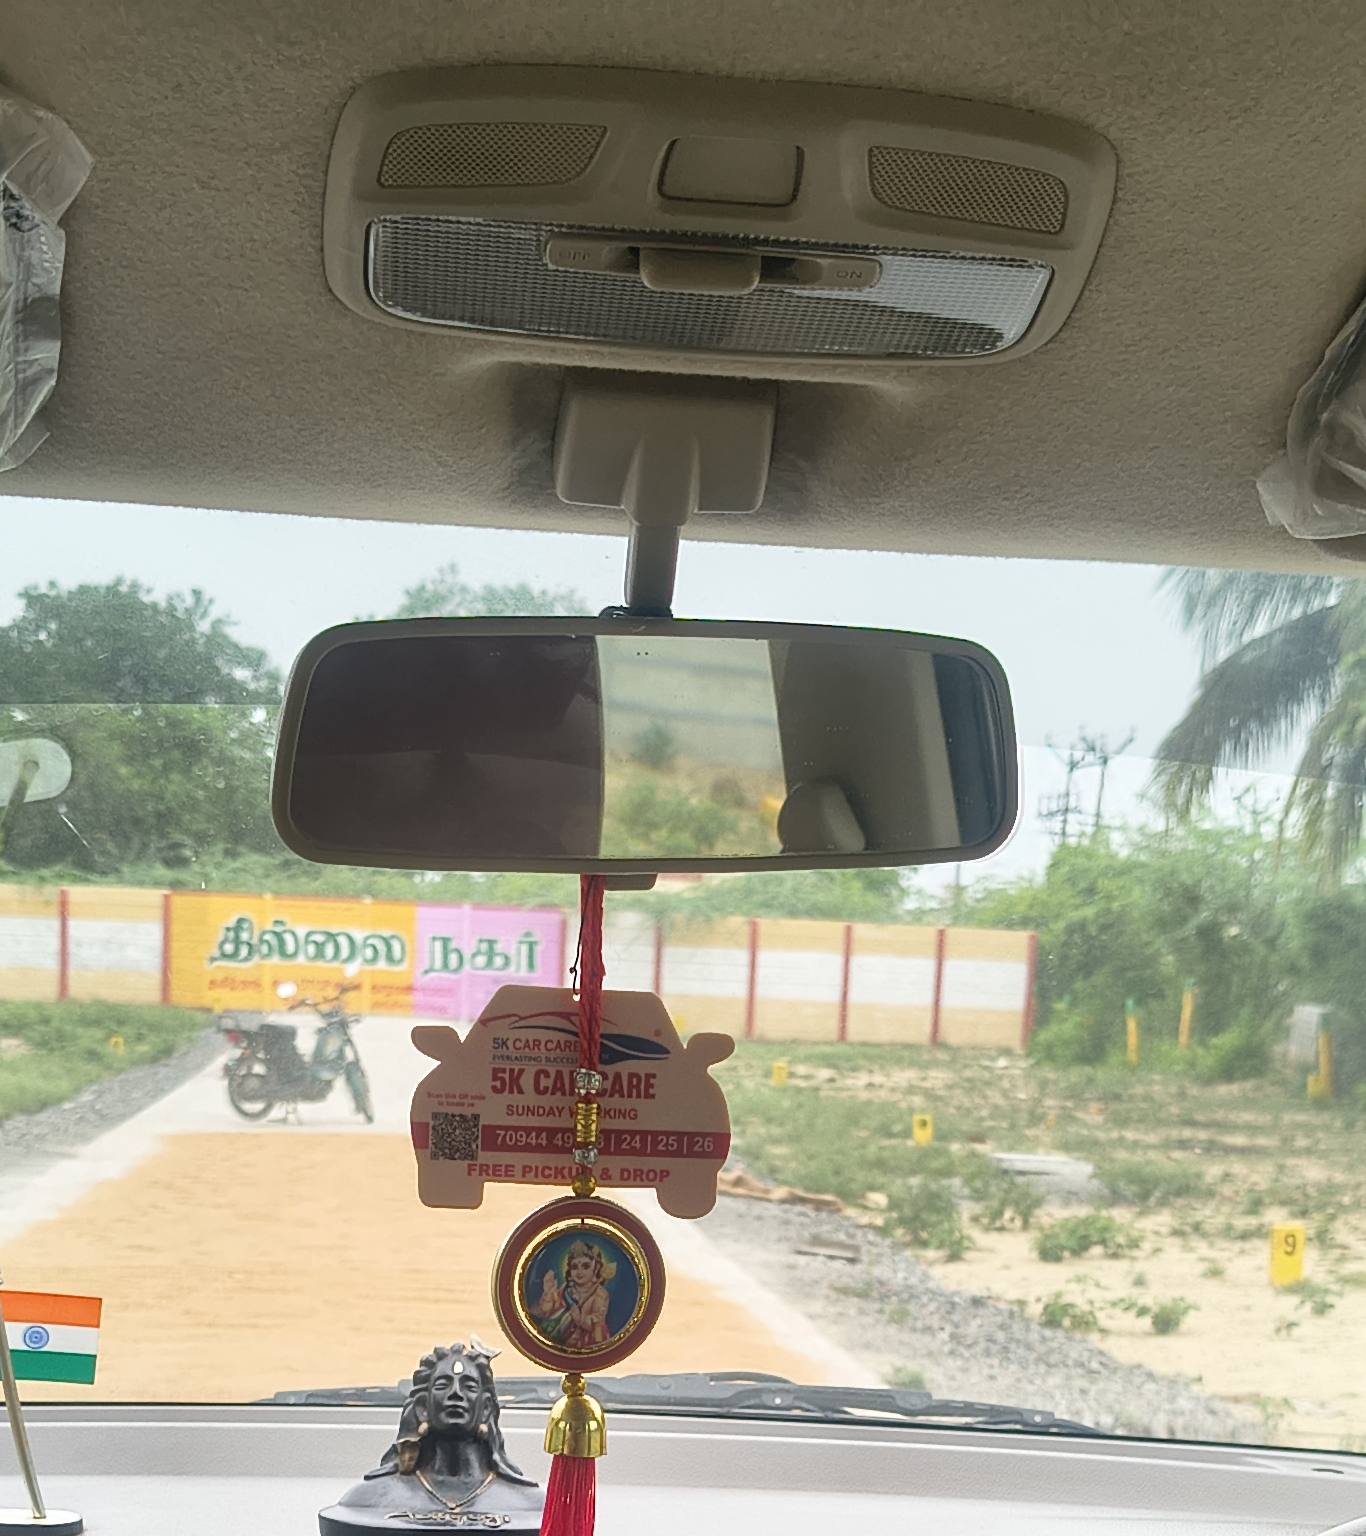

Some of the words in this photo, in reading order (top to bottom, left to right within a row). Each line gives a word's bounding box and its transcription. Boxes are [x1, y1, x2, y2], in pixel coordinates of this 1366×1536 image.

[209, 917, 406, 966] தில்லை
[423, 931, 538, 976] நகர்
[492, 1037, 510, 1051] 5K
[512, 1038, 542, 1052] CAR
[544, 1039, 580, 1052] CARE
[491, 1068, 524, 1096] 5K
[598, 1070, 657, 1100] CARE
[506, 1104, 566, 1119] SUNDAY
[569, 1106, 638, 1120] KING
[495, 1129, 548, 1147] 70944
[552, 1132, 605, 1148] 493
[620, 1134, 642, 1150] 24
[657, 1136, 678, 1151] 25
[693, 1137, 714, 1152] 26
[467, 1163, 516, 1179] FREE
[599, 1167, 612, 1181] &
[619, 1168, 671, 1183] DROP
[1283, 1233, 1297, 1256] 9
